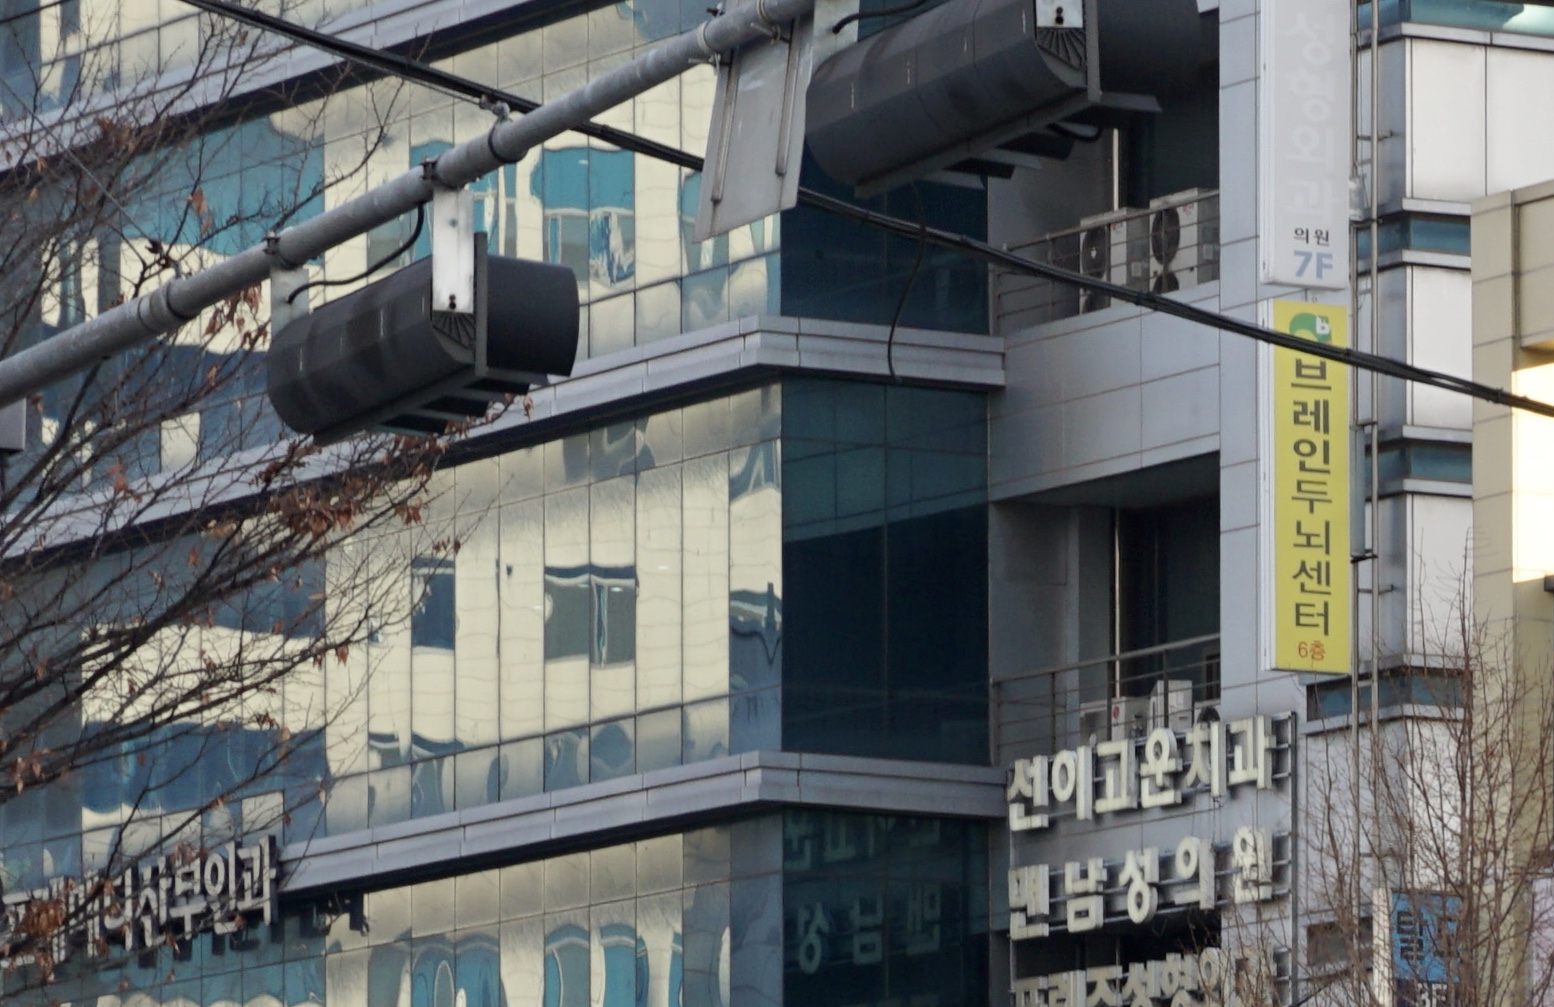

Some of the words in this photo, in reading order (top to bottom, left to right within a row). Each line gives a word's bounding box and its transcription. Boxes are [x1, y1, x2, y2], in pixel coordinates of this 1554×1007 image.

[1294, 228, 1330, 247] 의원
[1294, 250, 1333, 280] 7F
[1297, 640, 1327, 661] 6층
[1007, 714, 1277, 831] 선이고운치과
[1008, 825, 1273, 941] 맨남성의원
